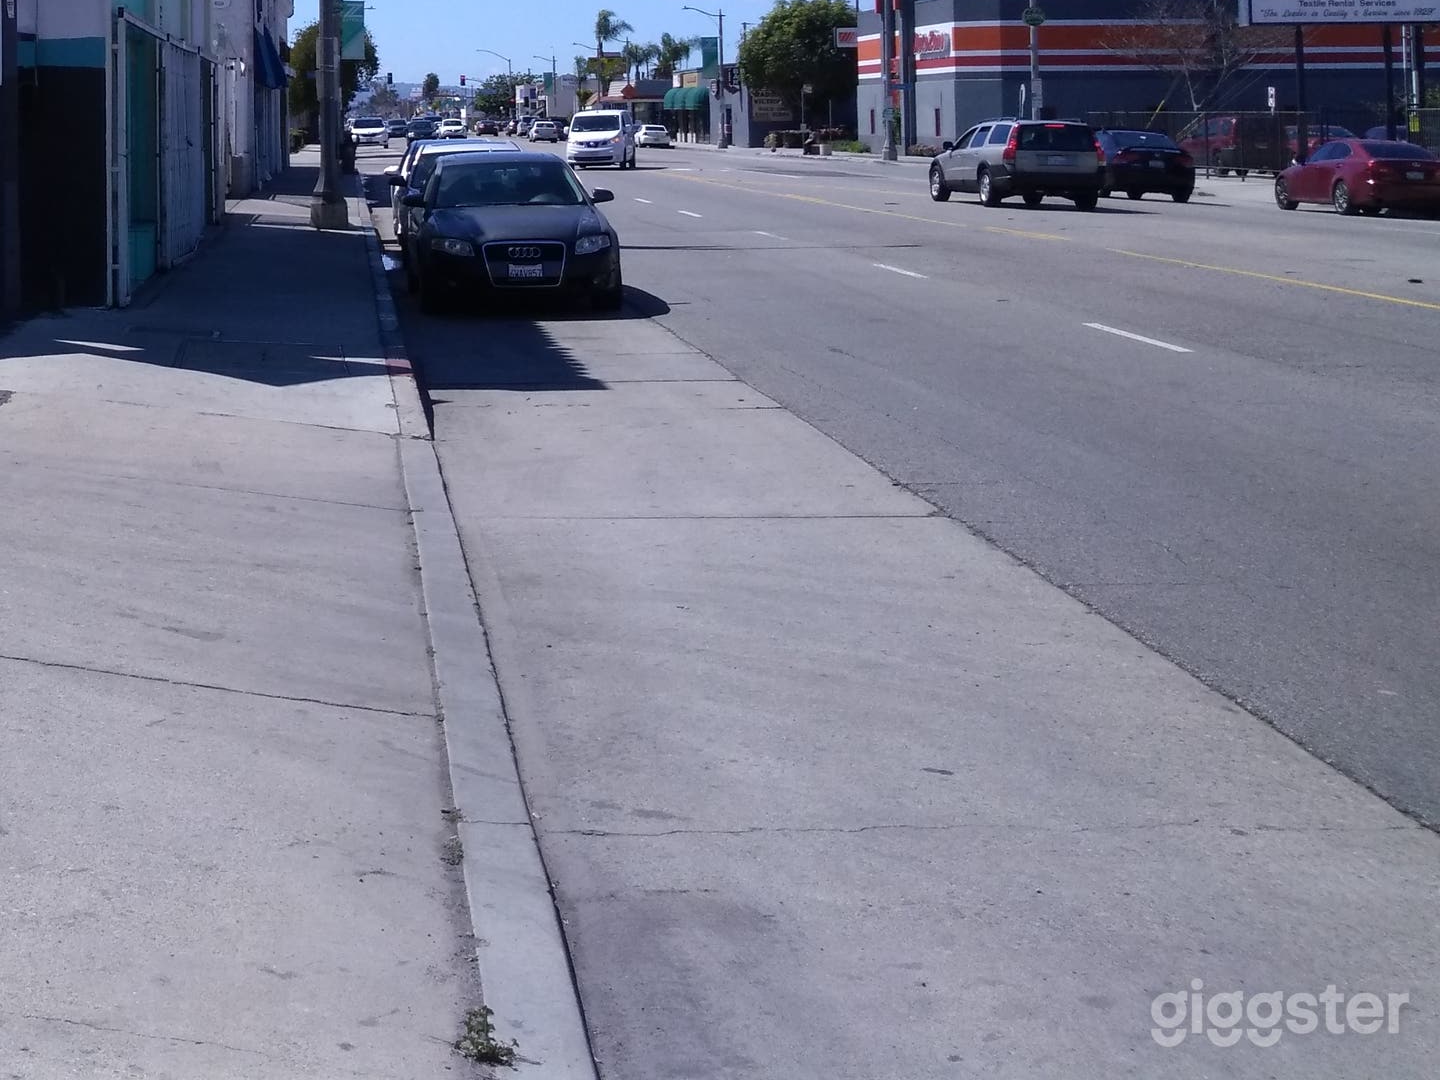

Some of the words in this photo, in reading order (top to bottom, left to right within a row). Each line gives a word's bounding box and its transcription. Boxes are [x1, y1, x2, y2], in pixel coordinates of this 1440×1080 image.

[1299, 0, 1327, 8] Textile
[1328, 0, 1356, 8] Rental
[1359, 0, 1397, 8] Services
